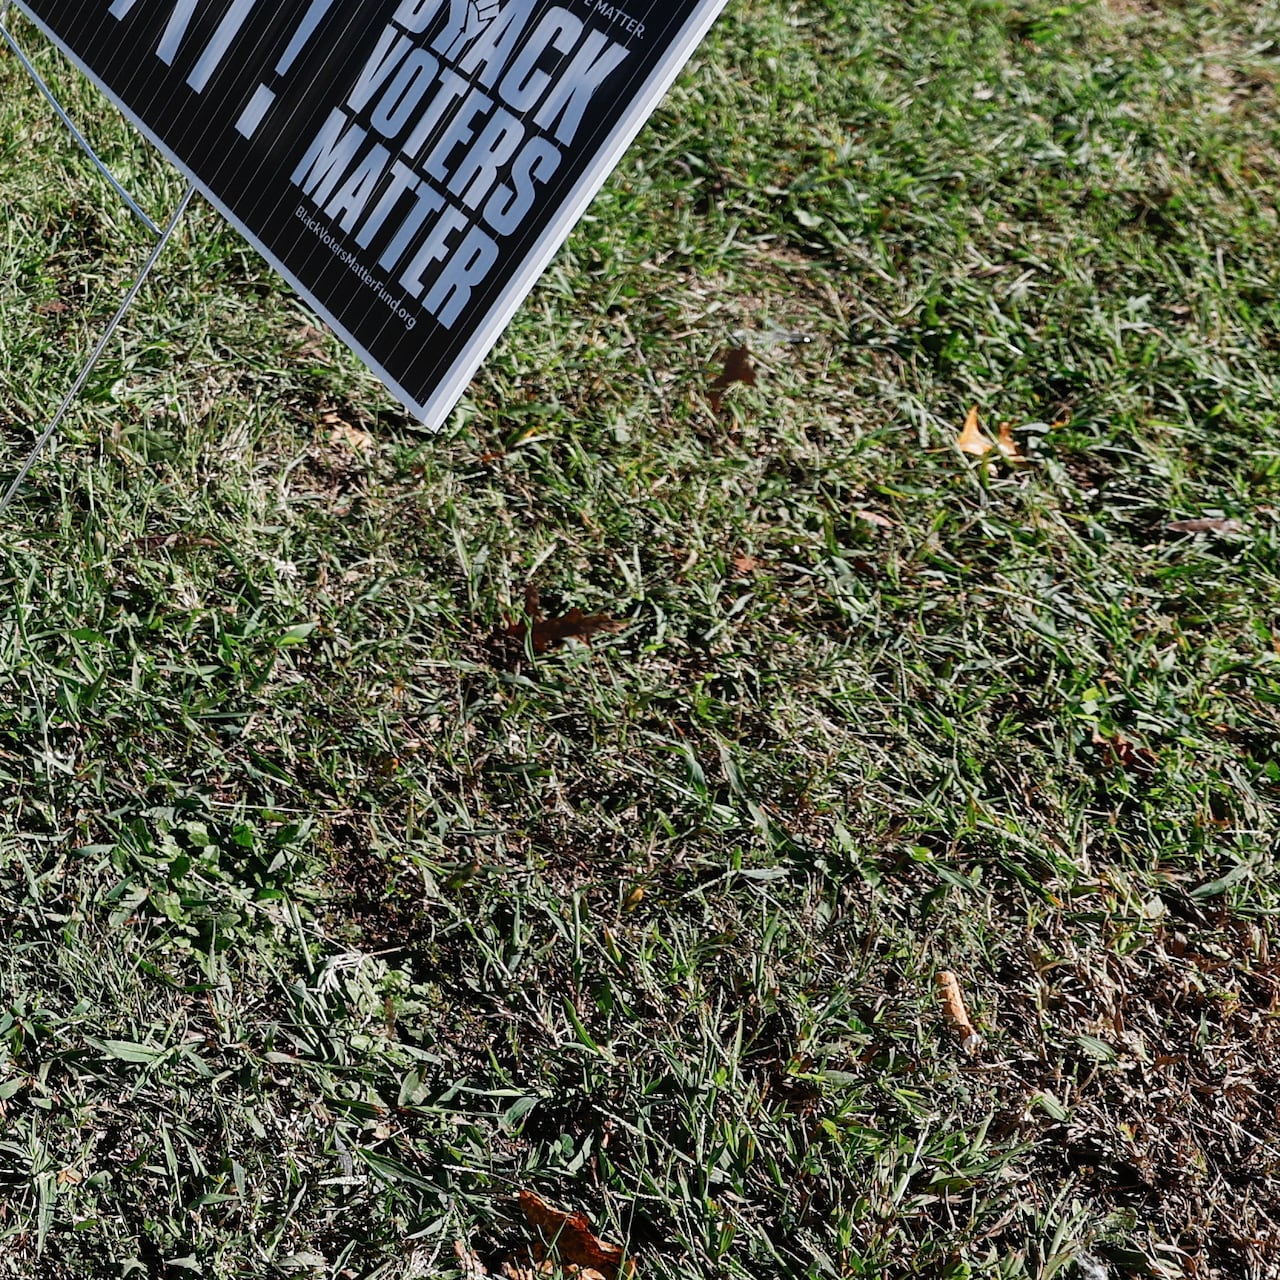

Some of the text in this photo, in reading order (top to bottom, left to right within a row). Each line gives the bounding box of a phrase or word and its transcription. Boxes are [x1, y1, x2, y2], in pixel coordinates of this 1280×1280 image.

[595, 0, 644, 39] MATTER.
[347, 23, 562, 237] VOTERS
[289, 106, 500, 330] MATTER
[295, 205, 417, 330] BlackVotersMatterFund.org
